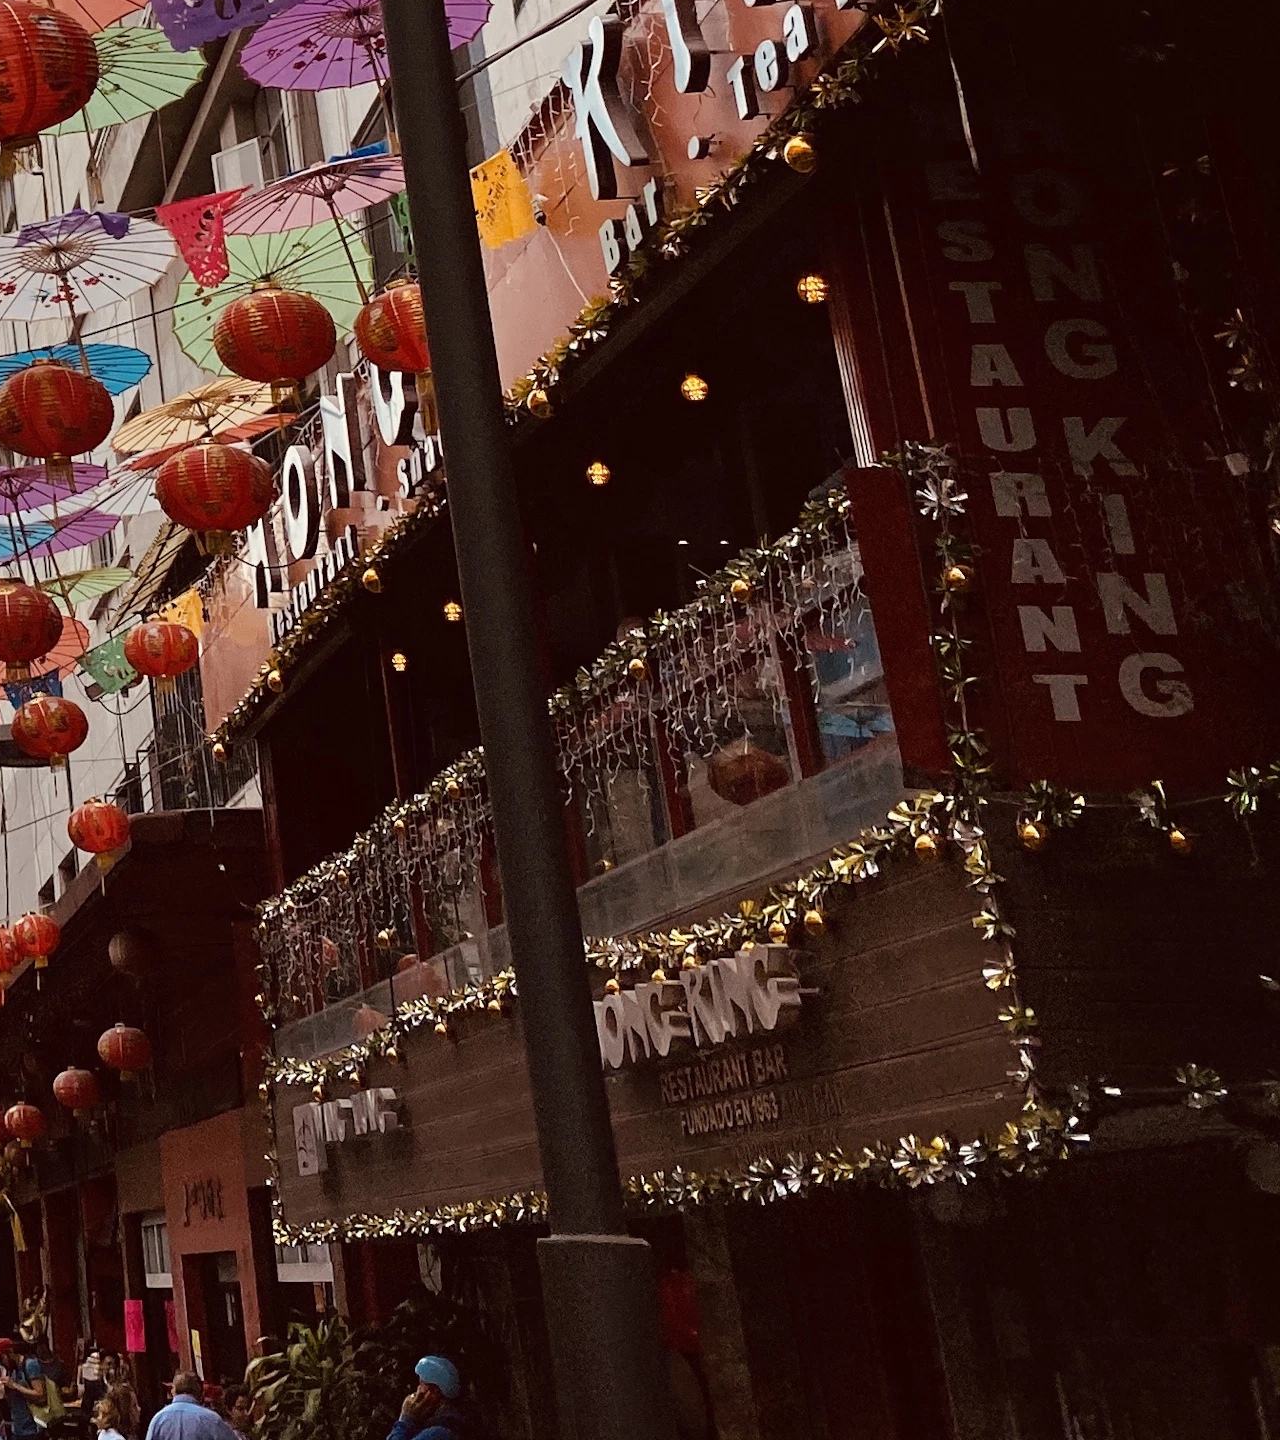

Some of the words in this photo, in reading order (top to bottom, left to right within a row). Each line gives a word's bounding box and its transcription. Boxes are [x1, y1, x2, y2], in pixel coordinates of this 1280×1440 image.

[726, 4, 814, 121] Tea
[1011, 167, 1119, 381] ONG
[927, 160, 1089, 722] ESTAURANT
[1062, 416, 1195, 719] KING
[659, 1051, 750, 1104] RESTAURANT
[752, 1043, 788, 1084] BAR
[680, 1100, 733, 1137] FUNDADO
